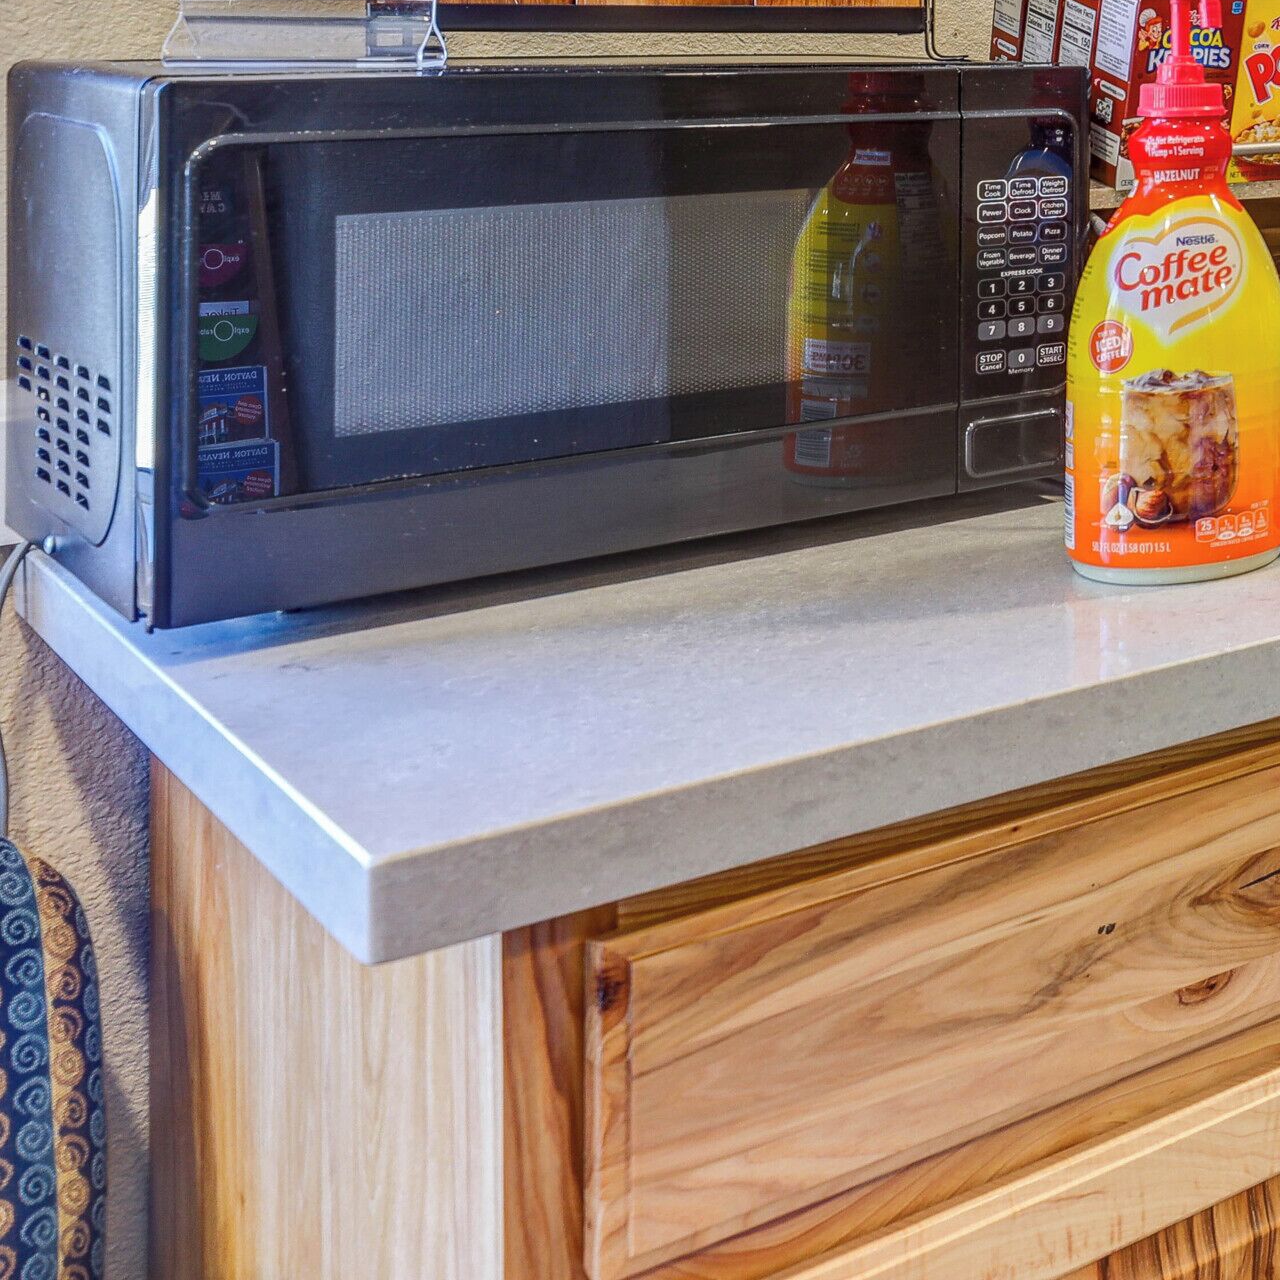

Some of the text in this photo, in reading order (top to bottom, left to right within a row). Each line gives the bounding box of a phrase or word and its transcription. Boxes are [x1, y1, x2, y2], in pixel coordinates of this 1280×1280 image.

[1066, 1, 1094, 20] Nutrition Facts
[1063, 30, 1091, 49] Calories 150
[1254, 43, 1270, 51] CORN
[1167, 136, 1205, 145] Refrigerate
[1178, 146, 1204, 157] Serving
[1153, 168, 1201, 183] HAZELNUT
[984, 183, 1002, 191] Time
[1015, 181, 1031, 189] Time
[1042, 179, 1064, 188] Weight
[984, 190, 1002, 198] Cook
[1011, 187, 1035, 196] Defrost
[1042, 185, 1065, 194] Defrost
[1014, 206, 1032, 215] Clock
[1041, 201, 1064, 210] Kitchen
[982, 209, 1003, 218] Power
[1043, 208, 1062, 216] Timer
[979, 231, 1005, 241] Popcorn
[1012, 229, 1033, 238] Potato
[1044, 227, 1061, 235] Pizza
[983, 251, 1001, 260] Frozen
[1042, 246, 1063, 255] Dinner
[1009, 252, 1036, 262] Beverage
[1044, 253, 1060, 261] Plate
[979, 258, 1005, 268] Vegetable
[1001, 268, 1043, 278] EXPRESS COOK
[1114, 245, 1228, 292] Coffee
[989, 277, 1055, 294] 1 2 3
[1141, 266, 1233, 312] mate
[988, 298, 1054, 315] 4 5 6
[988, 319, 1054, 336] 7 8 9
[1095, 337, 1122, 352] ICED
[1039, 344, 1063, 356] START
[979, 353, 1003, 364] STOP
[1018, 353, 1025, 363] 0
[1039, 354, 1063, 364] +30SEC
[980, 361, 1003, 371] Cancel
[1008, 366, 1034, 375] Memory
[1139, 542, 1153, 553] QT)
[1155, 542, 1165, 553] 1.5
[1166, 542, 1171, 553] L
